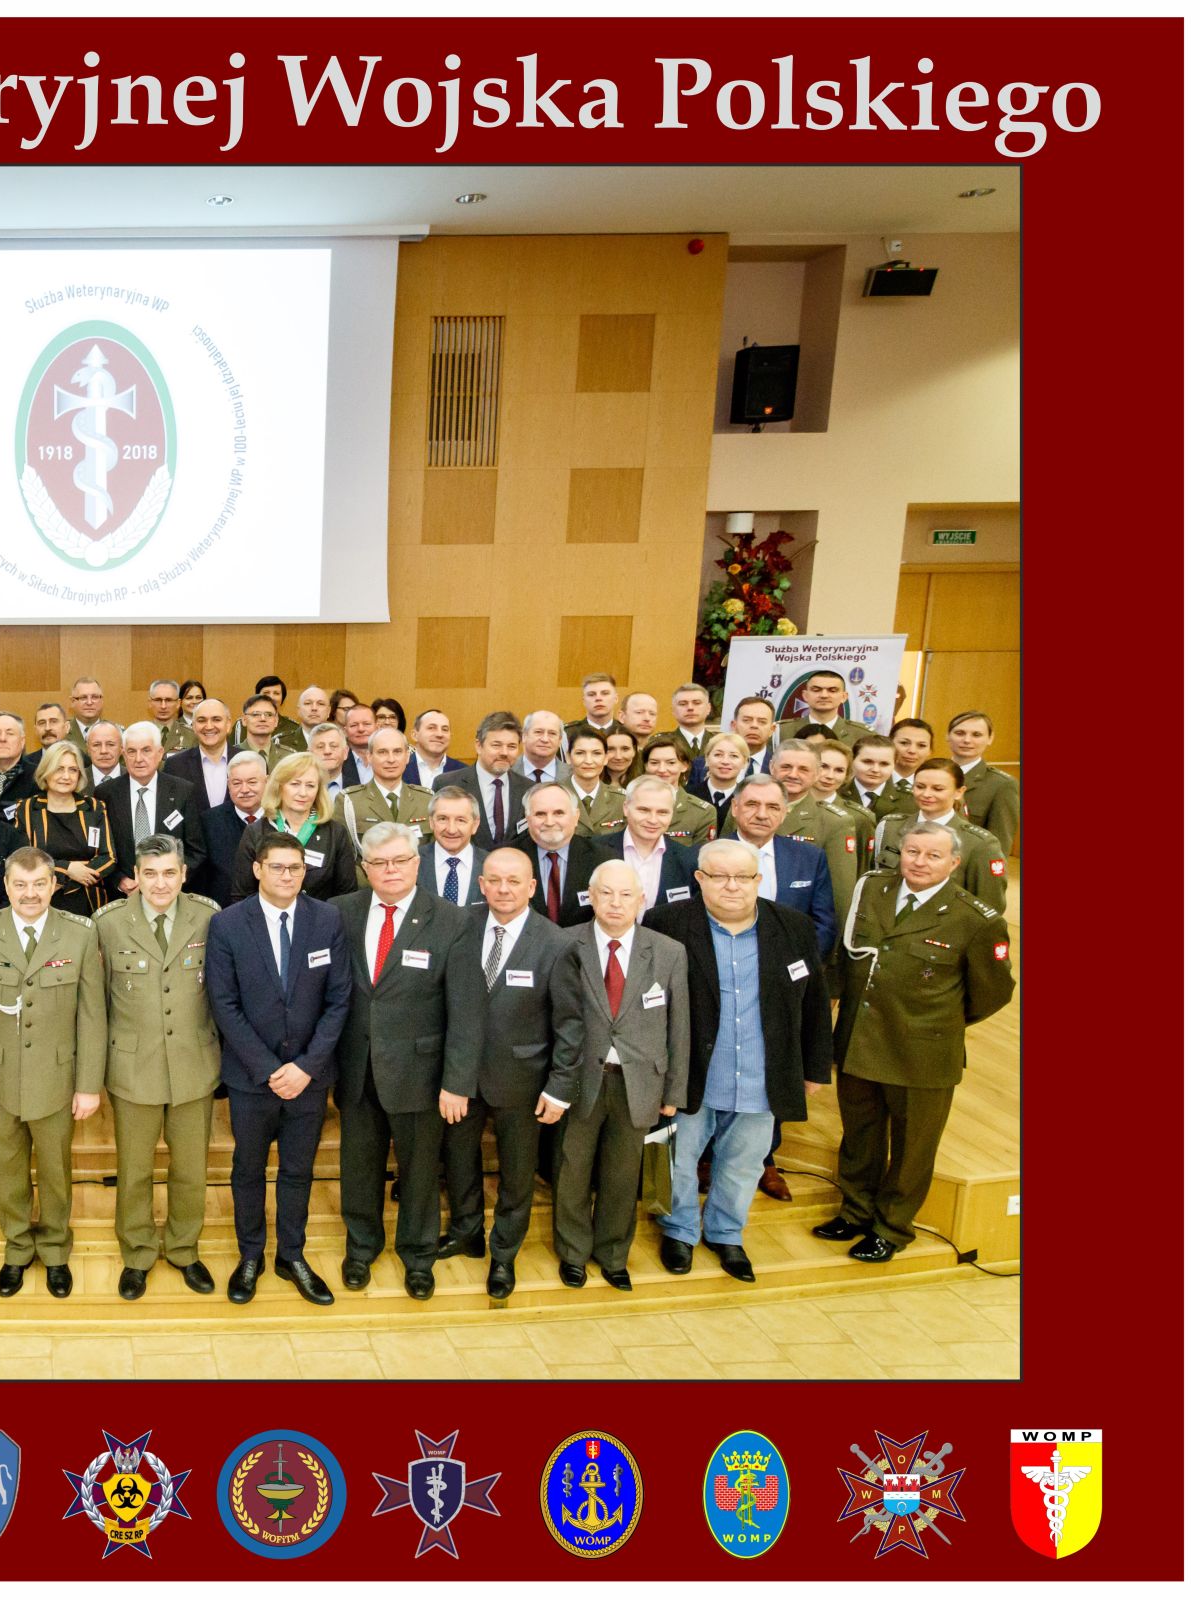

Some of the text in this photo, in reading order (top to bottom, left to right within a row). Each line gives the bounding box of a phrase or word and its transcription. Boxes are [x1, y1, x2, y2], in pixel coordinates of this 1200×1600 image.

[25, 284, 170, 314] Służba Weterynaryjna WP
[38, 445, 157, 460] 1918 2018
[17, 571, 28, 582] w
[27, 574, 59, 597] Siłach
[61, 586, 112, 606] Zbrojnych
[114, 587, 128, 601] RP
[187, 487, 242, 562] Weterynaryjnej
[229, 468, 243, 486] WP
[765, 644, 879, 653] Służba Weterynaryjna
[775, 653, 867, 663] Wojska Polskiego
